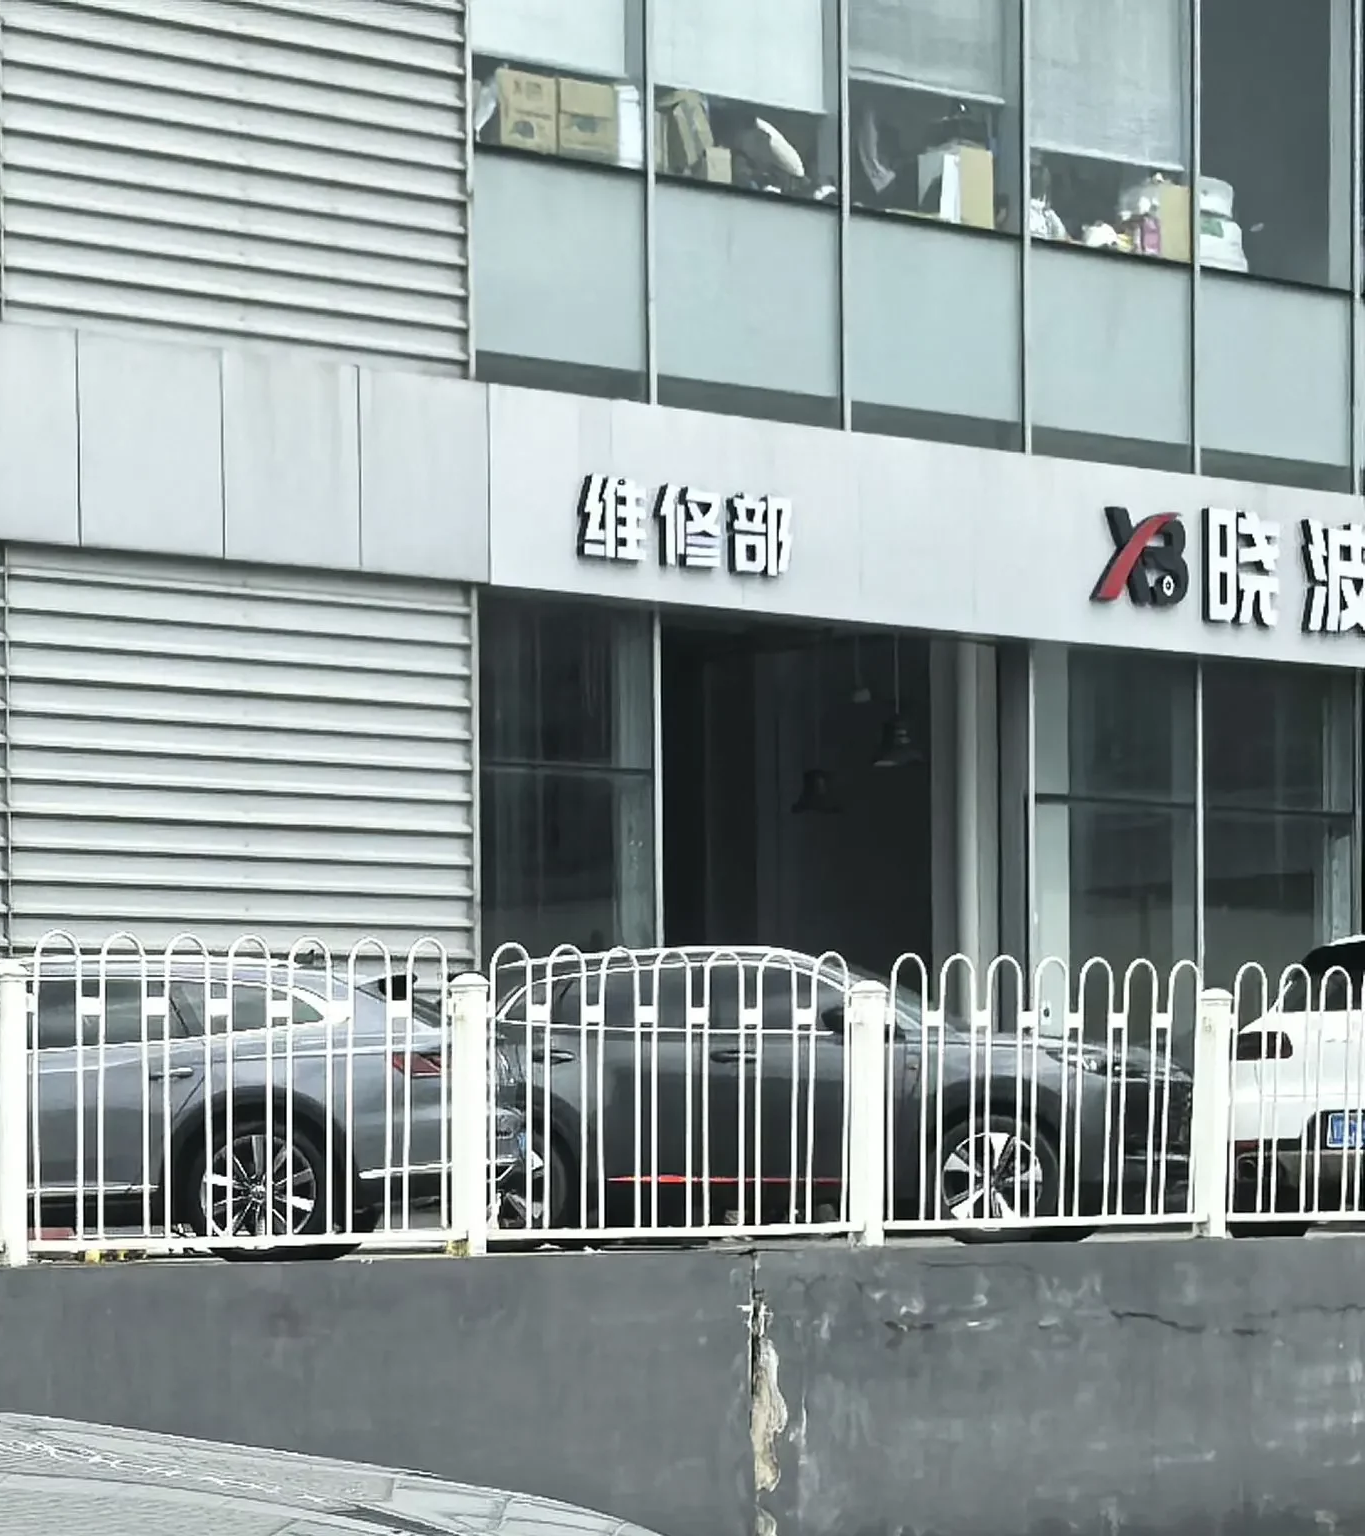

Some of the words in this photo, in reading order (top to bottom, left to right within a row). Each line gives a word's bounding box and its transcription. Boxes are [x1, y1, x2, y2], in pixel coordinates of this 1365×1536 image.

[577, 473, 793, 577] 维修部
[1201, 507, 1365, 632] 晓波
